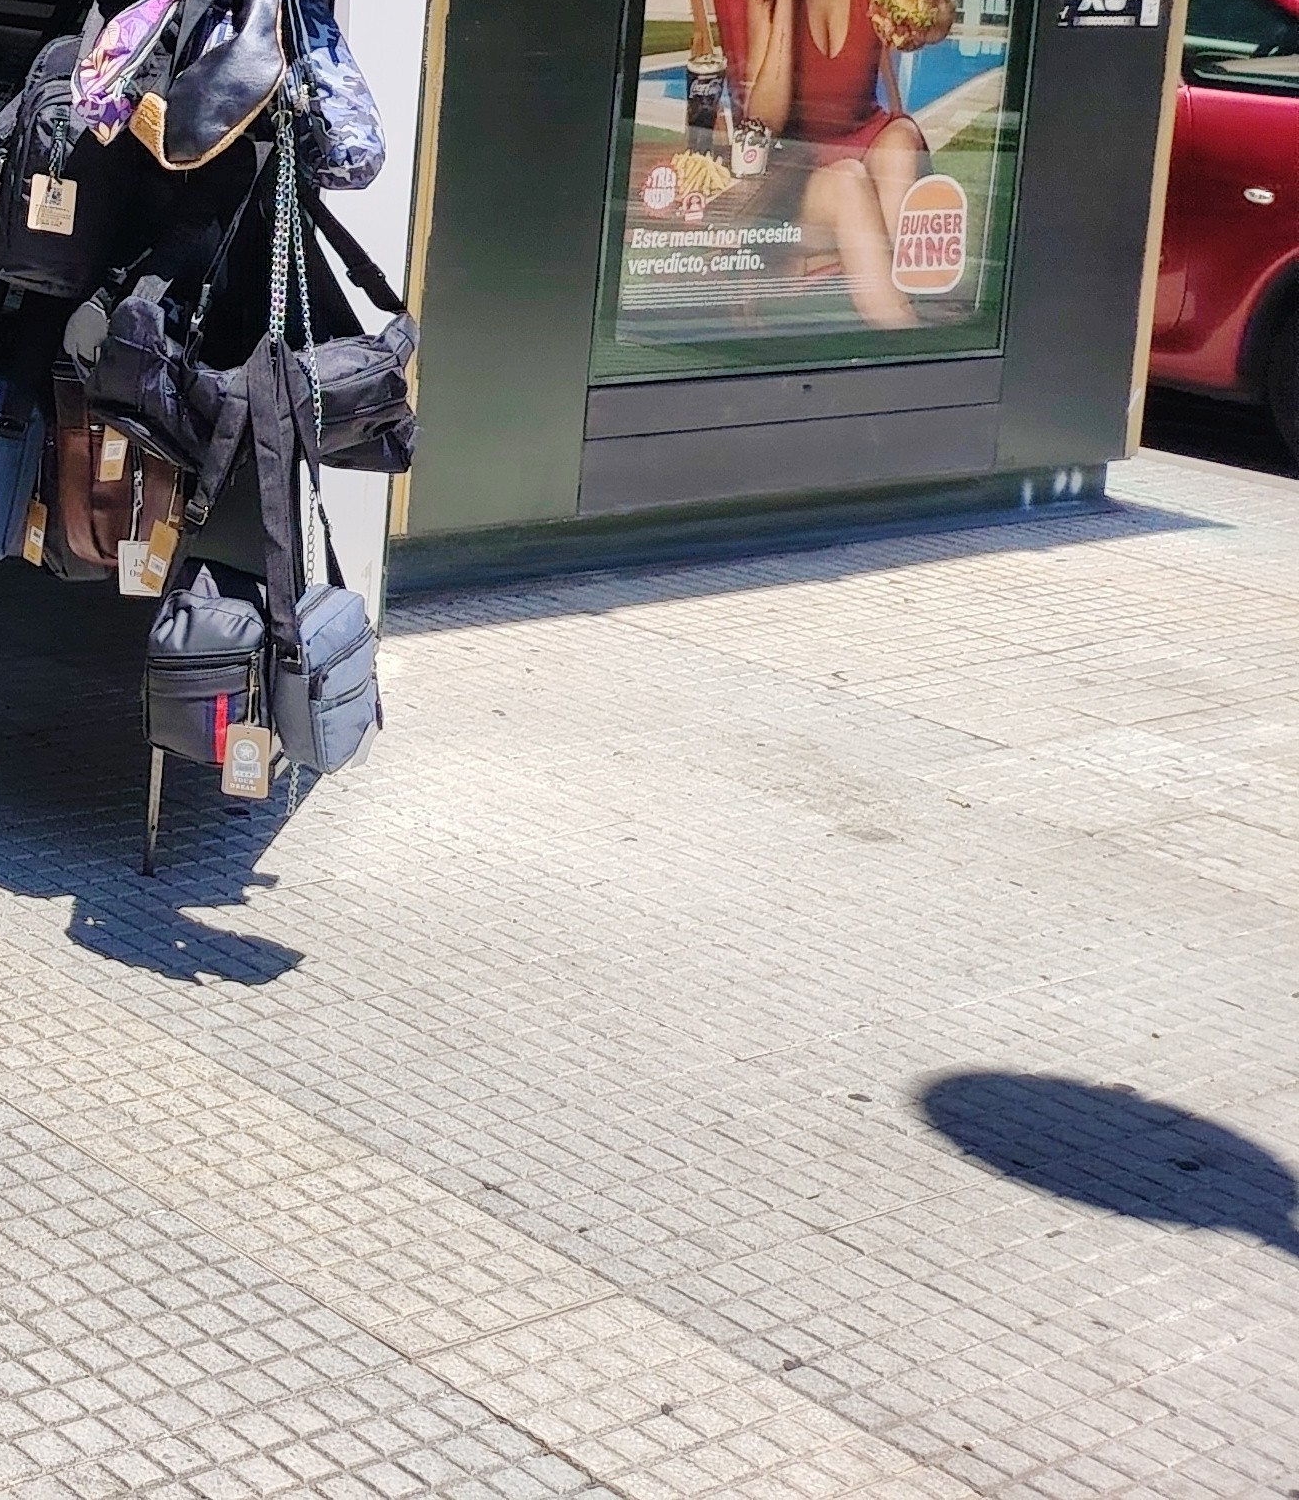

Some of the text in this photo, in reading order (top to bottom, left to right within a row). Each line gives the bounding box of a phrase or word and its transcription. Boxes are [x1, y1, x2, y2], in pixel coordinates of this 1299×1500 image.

[631, 221, 803, 249] Este menú no necesita
[900, 212, 963, 235] BURGER
[628, 248, 765, 276] veredicto, cariño.
[897, 235, 962, 268] KING
